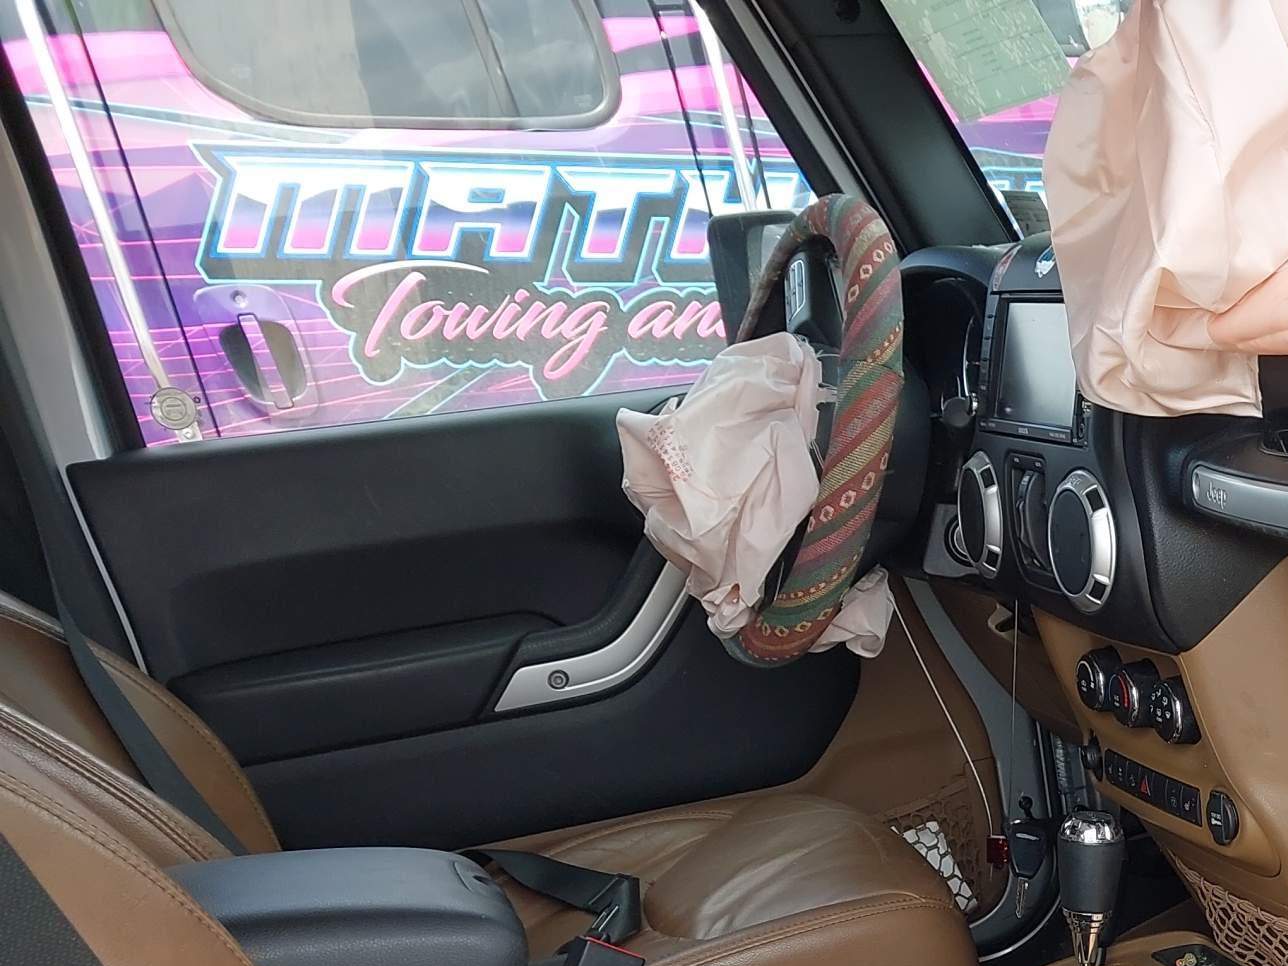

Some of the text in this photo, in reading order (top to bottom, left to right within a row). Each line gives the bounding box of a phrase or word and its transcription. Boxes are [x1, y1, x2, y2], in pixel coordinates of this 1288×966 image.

[210, 154, 815, 262] MATH
[331, 259, 727, 380] Towing an
[1206, 480, 1227, 510] Jeep
